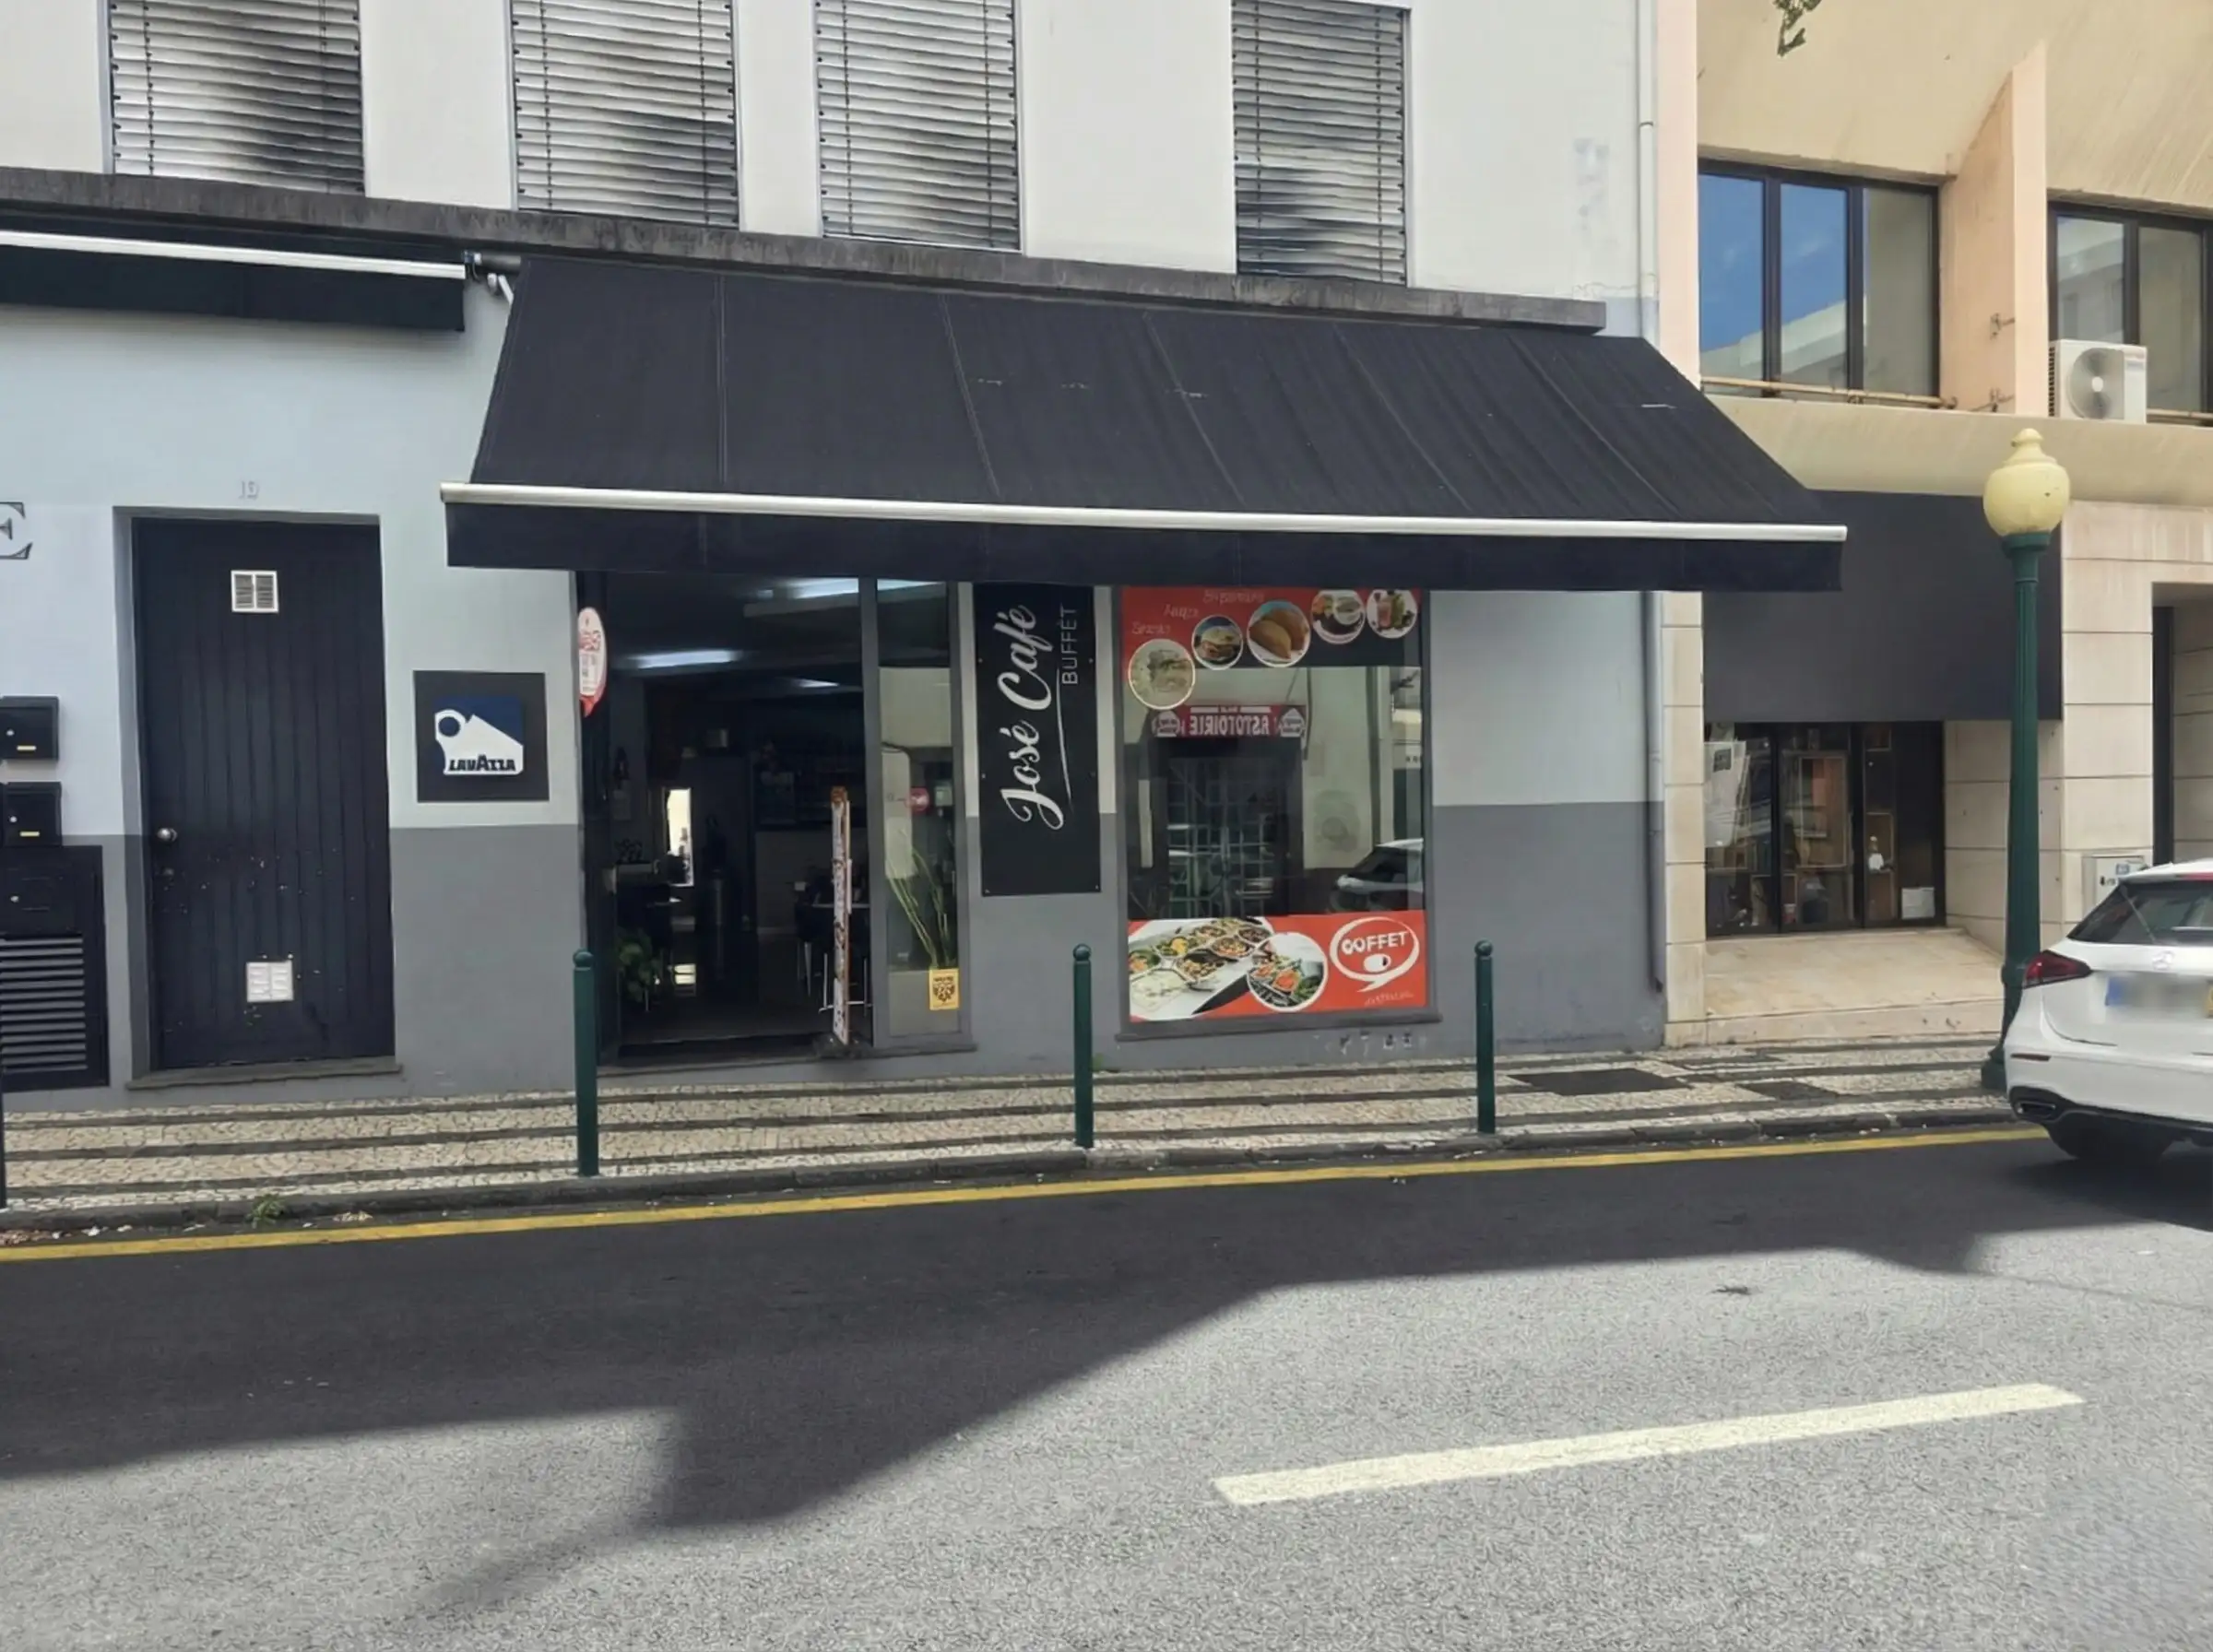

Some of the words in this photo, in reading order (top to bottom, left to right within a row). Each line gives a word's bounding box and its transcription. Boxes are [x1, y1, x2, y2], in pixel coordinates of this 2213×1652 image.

[993, 604, 1054, 711] Café
[448, 754, 516, 773] LAVAZZA
[1000, 720, 1064, 831] José
